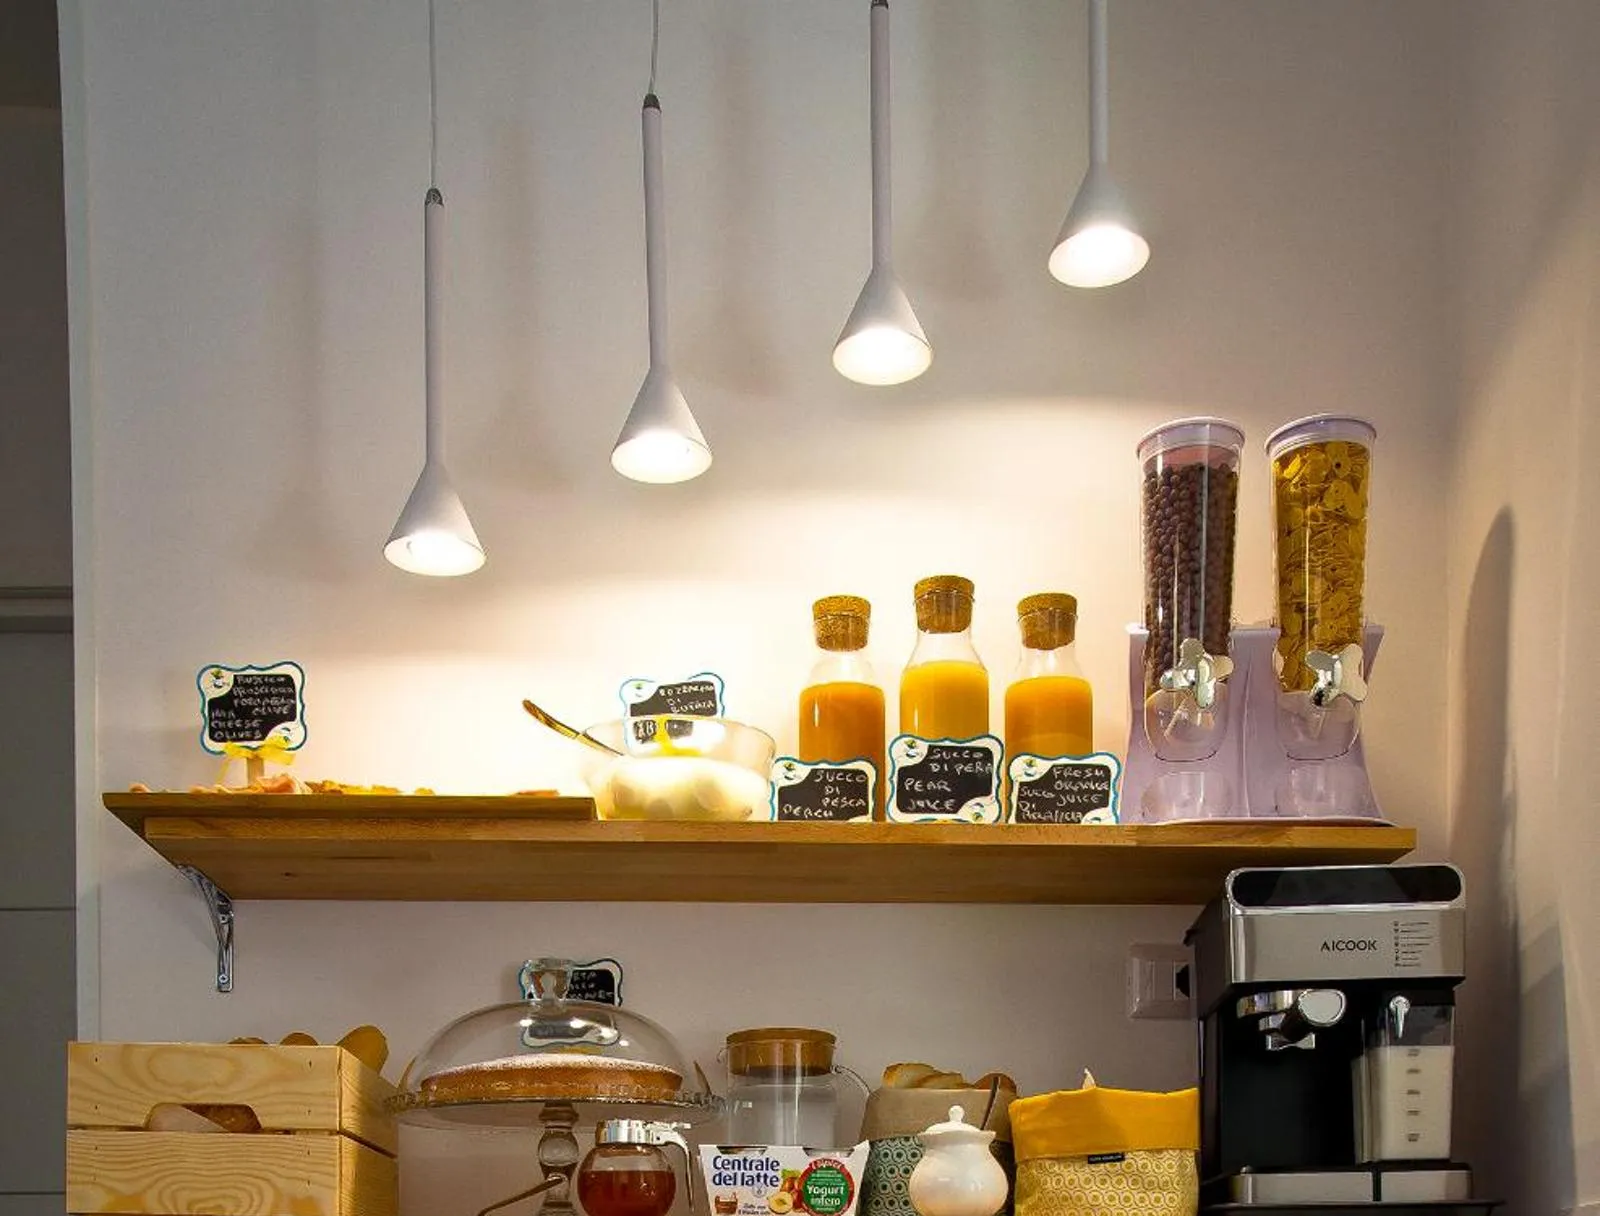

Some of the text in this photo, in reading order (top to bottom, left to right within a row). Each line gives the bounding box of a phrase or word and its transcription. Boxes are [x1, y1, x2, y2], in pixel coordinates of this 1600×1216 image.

[930, 748, 984, 760] SUCCO
[930, 761, 994, 775] DI PERA
[814, 769, 868, 783] SUCCO
[904, 777, 952, 792] PEAR
[822, 796, 867, 808] PESCA
[1320, 939, 1378, 952] AICOOK
[712, 1155, 780, 1172] Centrale
[712, 1171, 780, 1187] del latte
[806, 1184, 845, 1197] Yogurt
